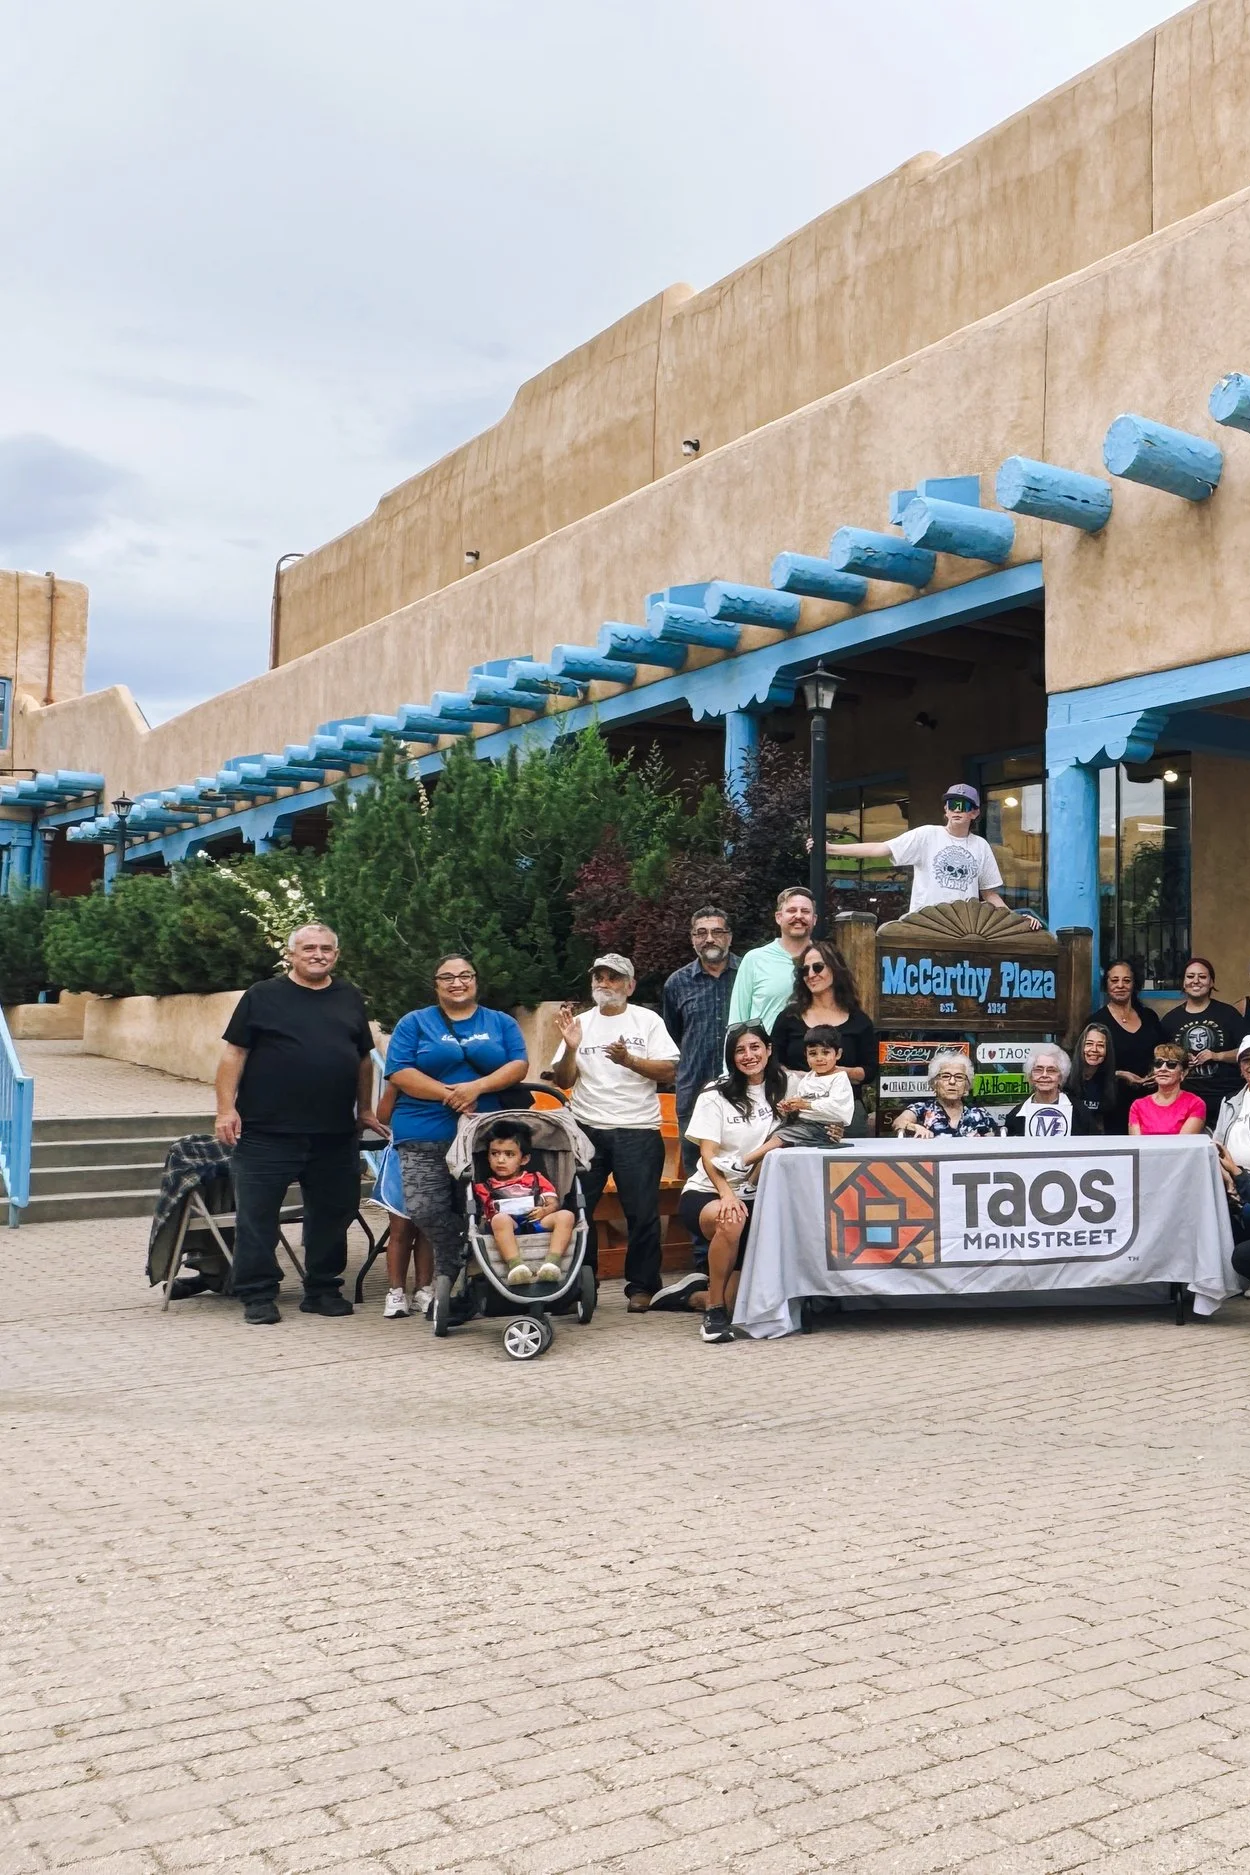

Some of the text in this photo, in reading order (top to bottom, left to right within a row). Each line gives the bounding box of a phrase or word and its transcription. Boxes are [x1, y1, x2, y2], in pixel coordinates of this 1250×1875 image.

[882, 956, 1056, 1003] McCarthy Plaza
[963, 1228, 1117, 1250] MAINSTREET
